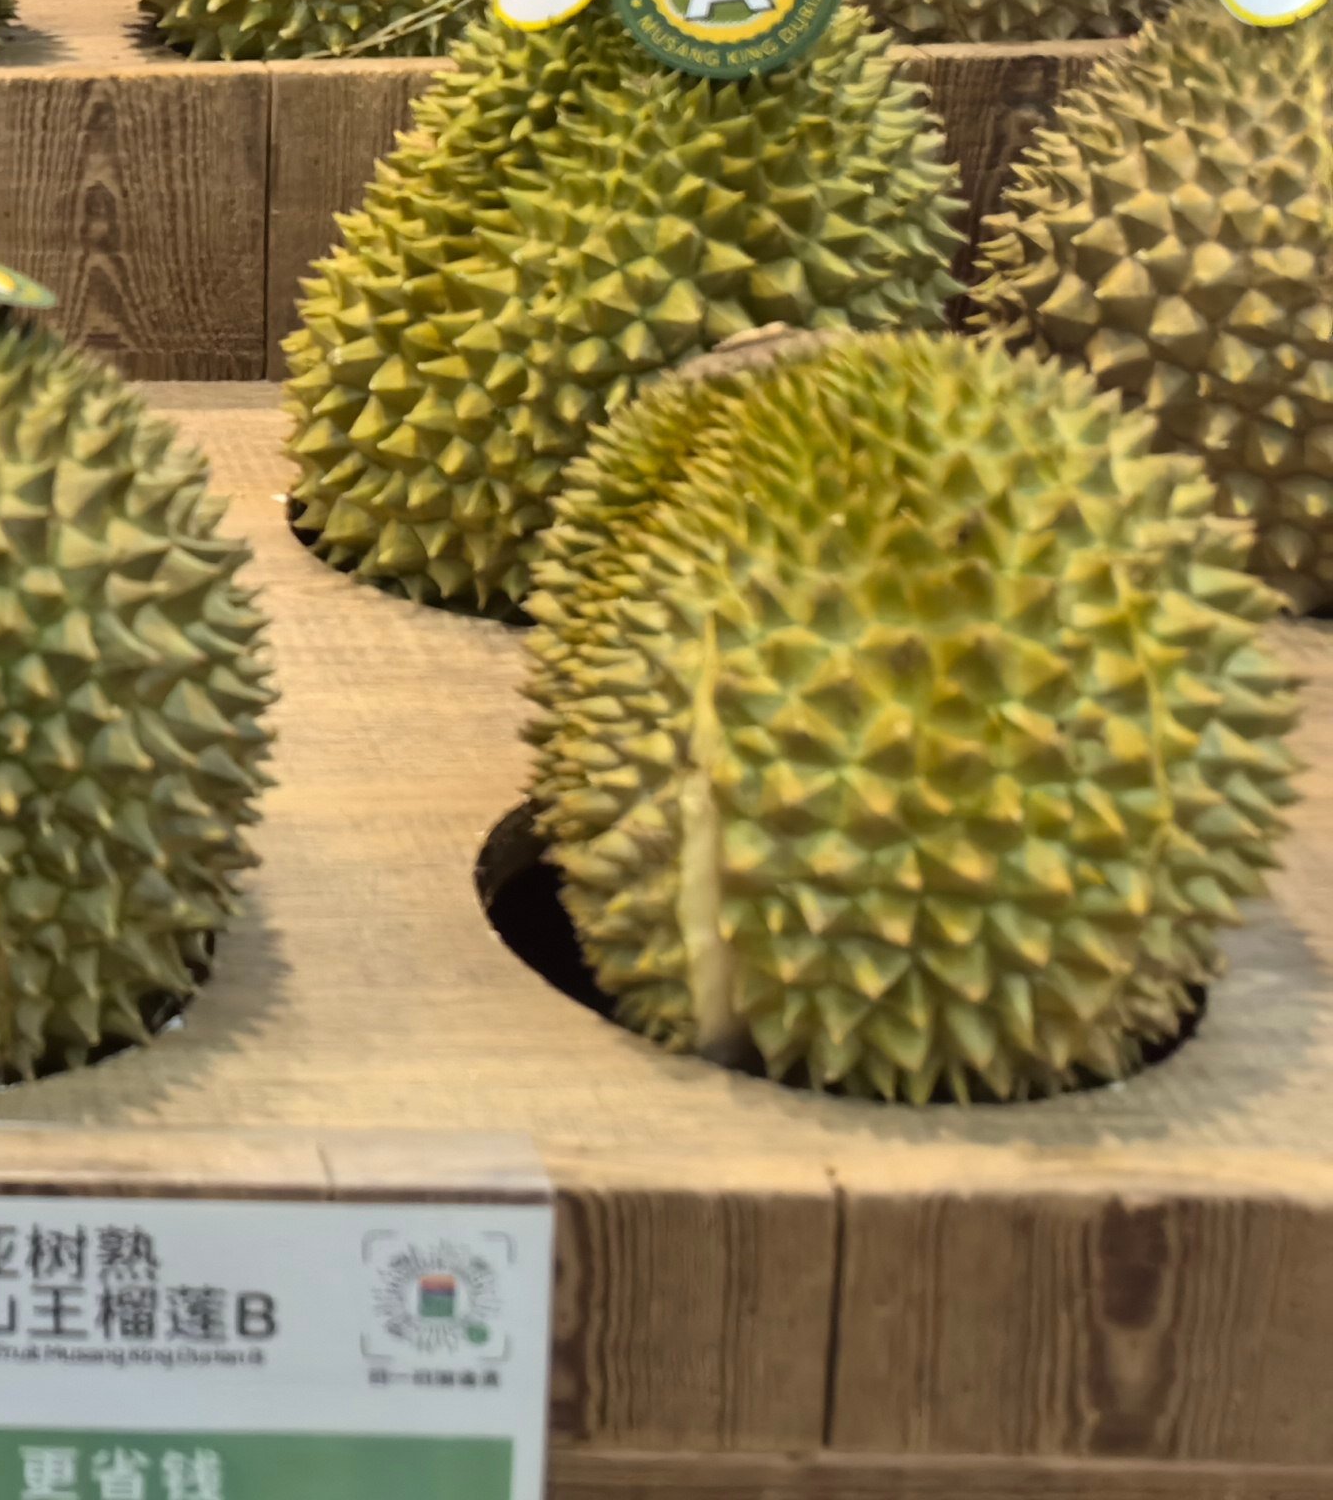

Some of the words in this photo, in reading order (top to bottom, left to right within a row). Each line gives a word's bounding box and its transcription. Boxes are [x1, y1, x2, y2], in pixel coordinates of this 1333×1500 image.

[637, 14, 722, 68] MUSANG
[726, 40, 781, 67] KING
[19, 1444, 226, 1500] 更省钱
